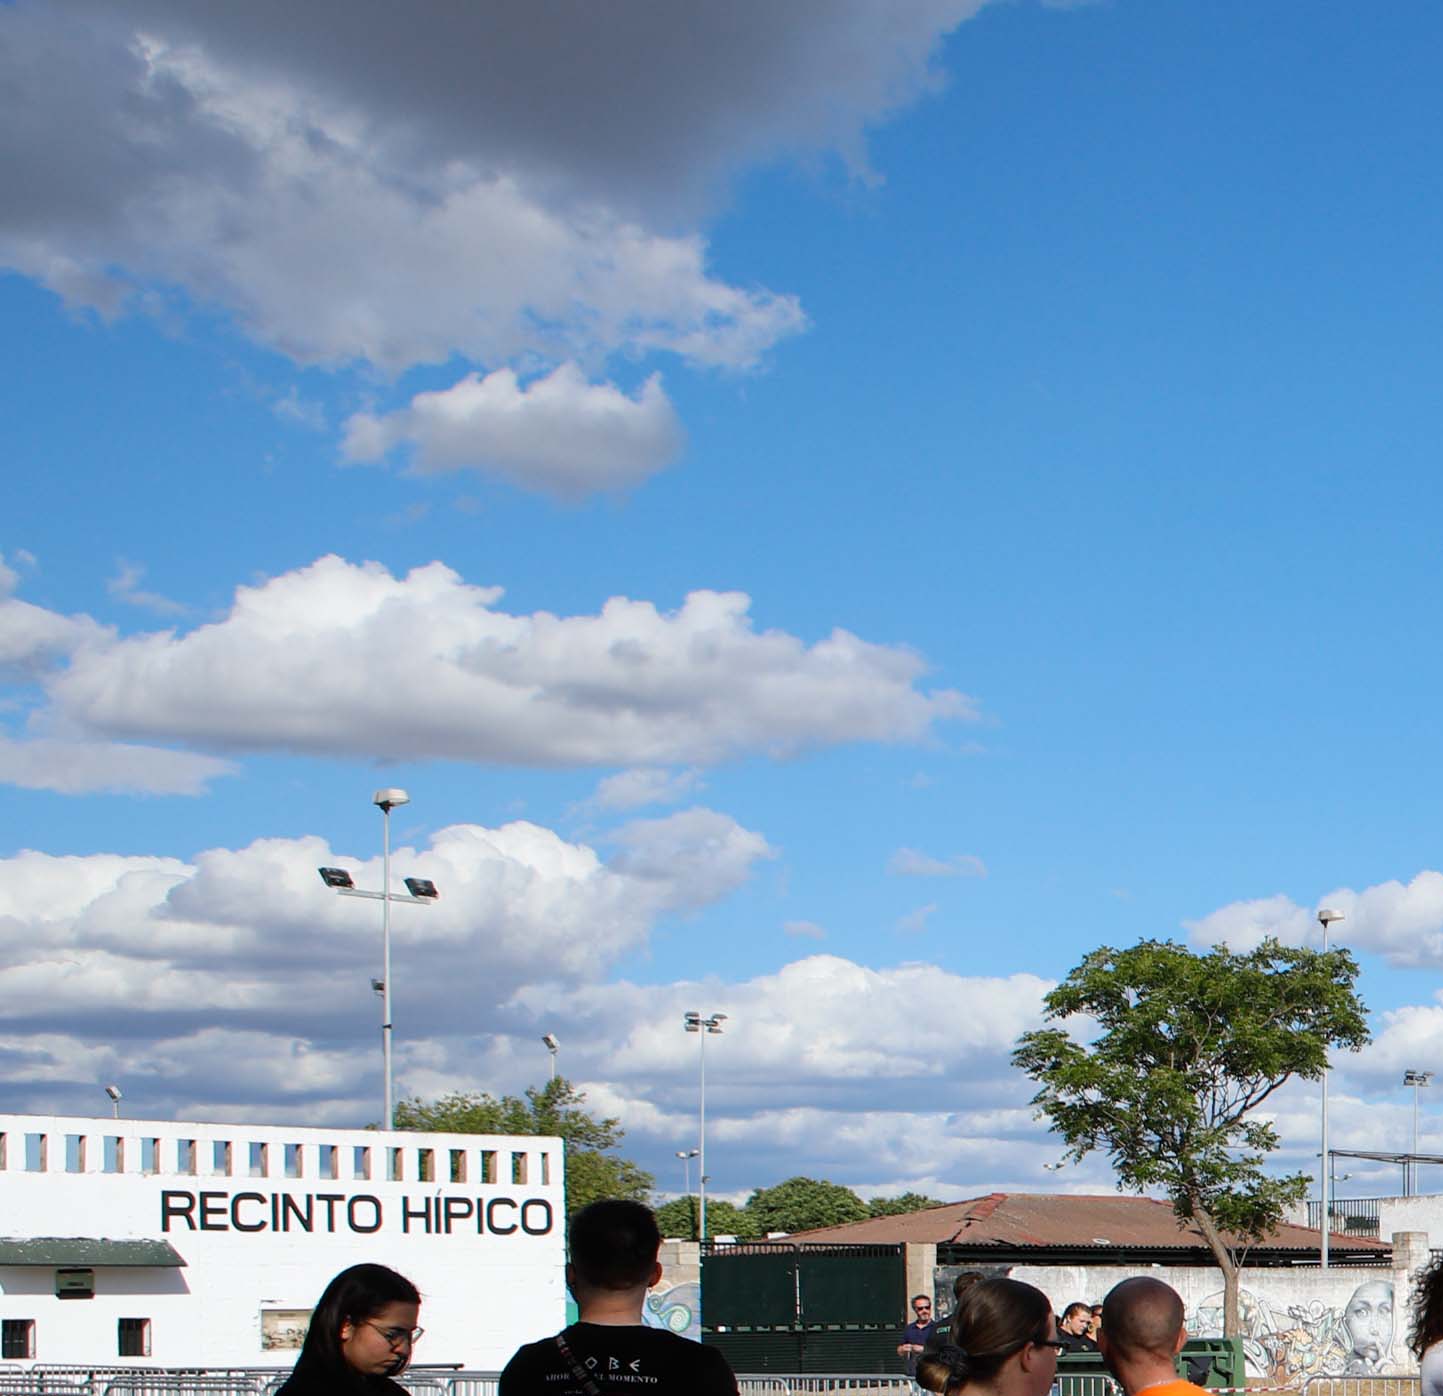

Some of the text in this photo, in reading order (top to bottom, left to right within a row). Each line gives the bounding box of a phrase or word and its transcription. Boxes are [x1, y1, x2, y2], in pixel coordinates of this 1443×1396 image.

[161, 1188, 553, 1236] RECINTO HÍPICO
[608, 1374, 658, 1384] MOMENTO
